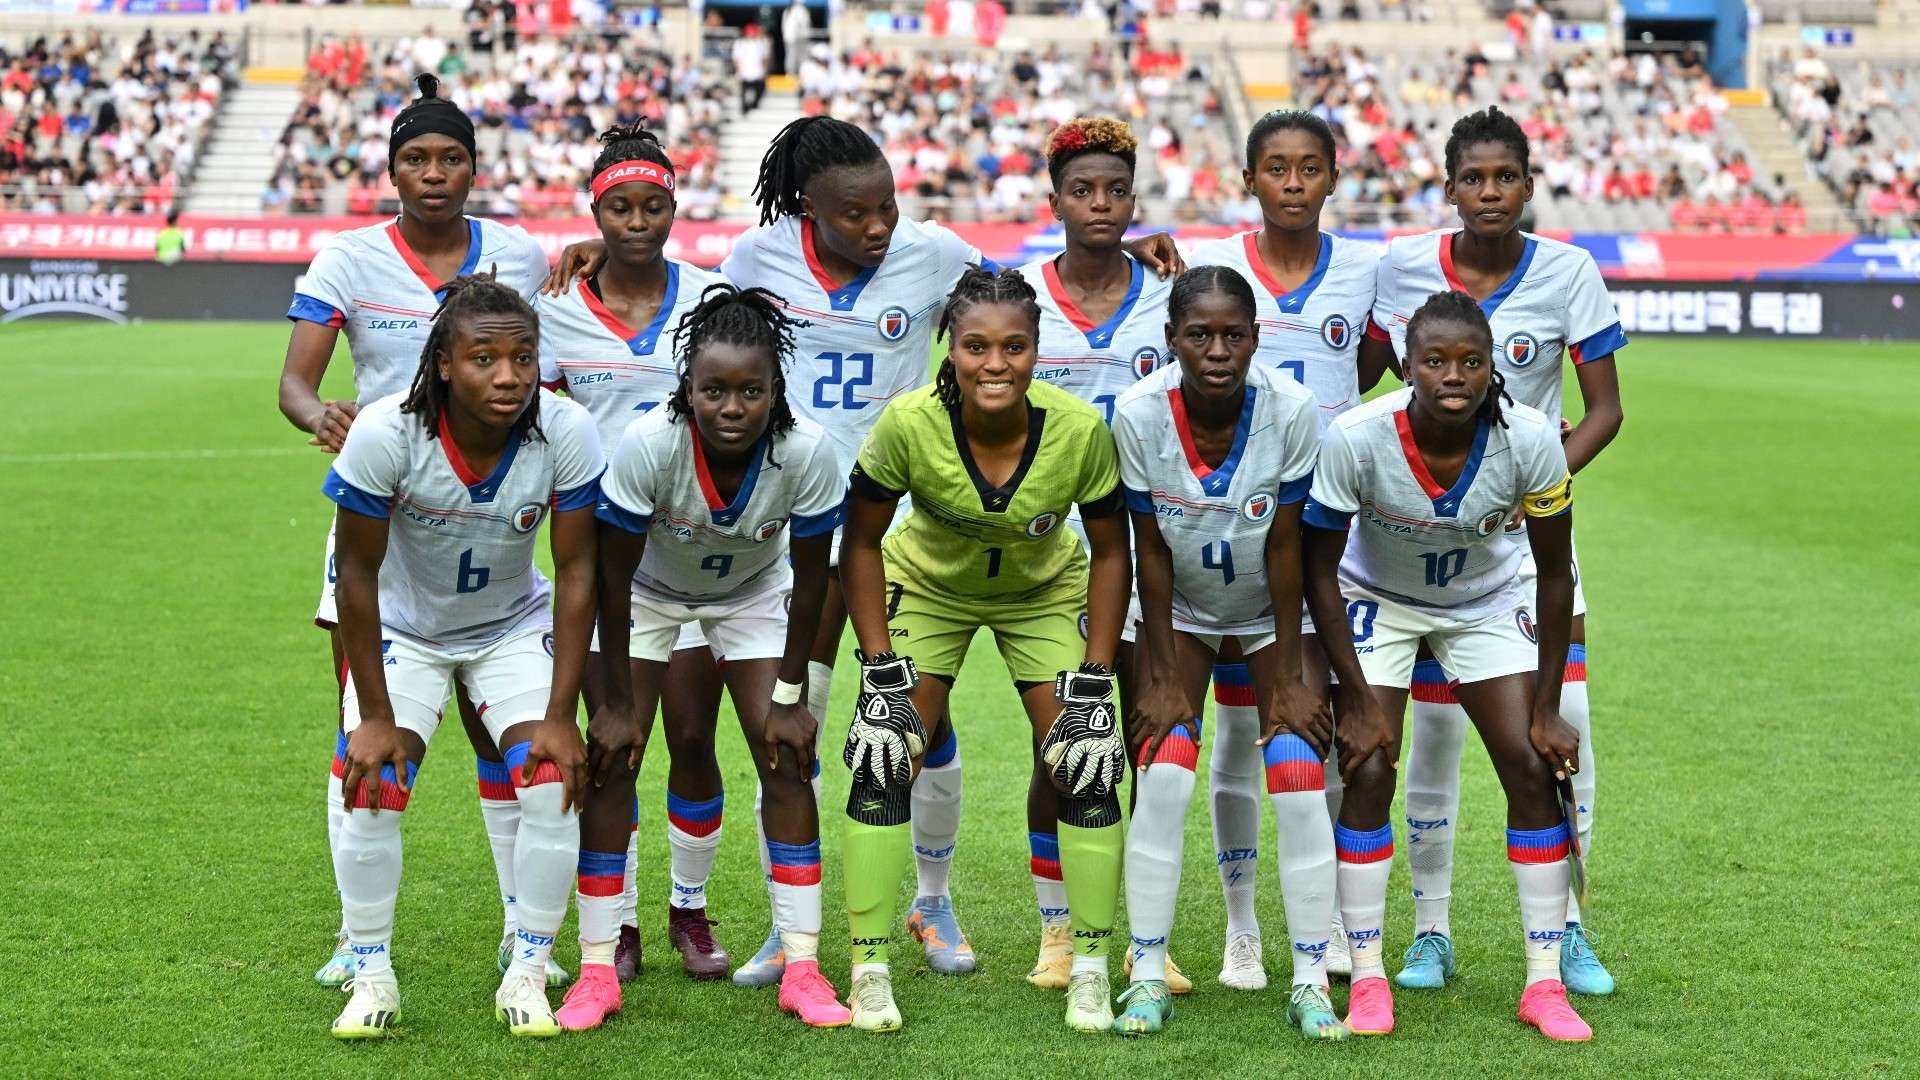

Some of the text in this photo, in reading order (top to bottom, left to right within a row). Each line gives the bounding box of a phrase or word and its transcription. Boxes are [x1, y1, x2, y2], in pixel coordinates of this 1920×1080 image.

[604, 166, 658, 183] SAETA
[367, 320, 418, 329] SAETA
[573, 371, 614, 386] SAETA
[813, 352, 873, 410] 22
[456, 548, 490, 593] 6
[701, 554, 734, 579] 9
[981, 548, 1003, 579] 1
[1202, 540, 1236, 586] 4
[1416, 549, 1468, 588] 10
[852, 936, 888, 946] SAETA
[1529, 931, 1565, 940] SAET
